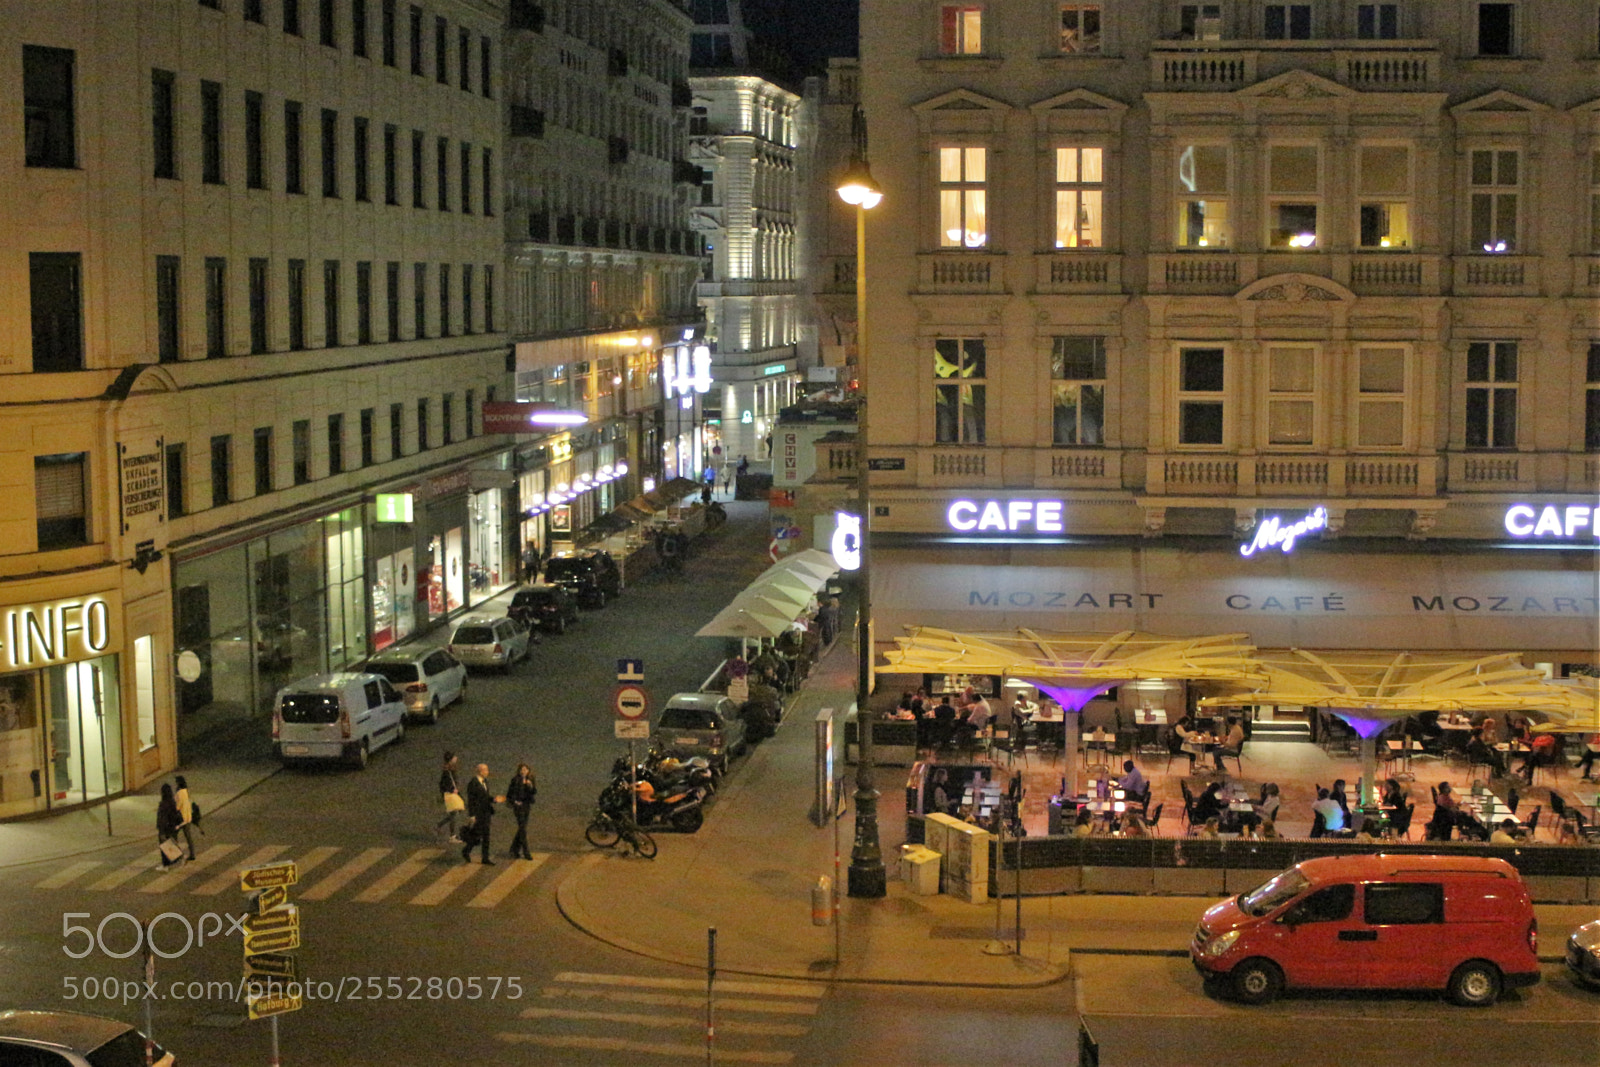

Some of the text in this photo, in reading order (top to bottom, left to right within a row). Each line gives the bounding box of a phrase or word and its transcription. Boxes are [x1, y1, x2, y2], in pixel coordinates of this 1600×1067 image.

[126, 467, 149, 480] UNFALL
[947, 500, 1064, 533] CAFE
[1504, 504, 1600, 540] CAF
[1240, 506, 1328, 556] Mozart
[969, 590, 1165, 611] MOZART
[1225, 592, 1346, 612] CAFÉ
[6, 598, 110, 666] INFO
[254, 877, 283, 886] Museum
[256, 997, 290, 1012] Hofburg
